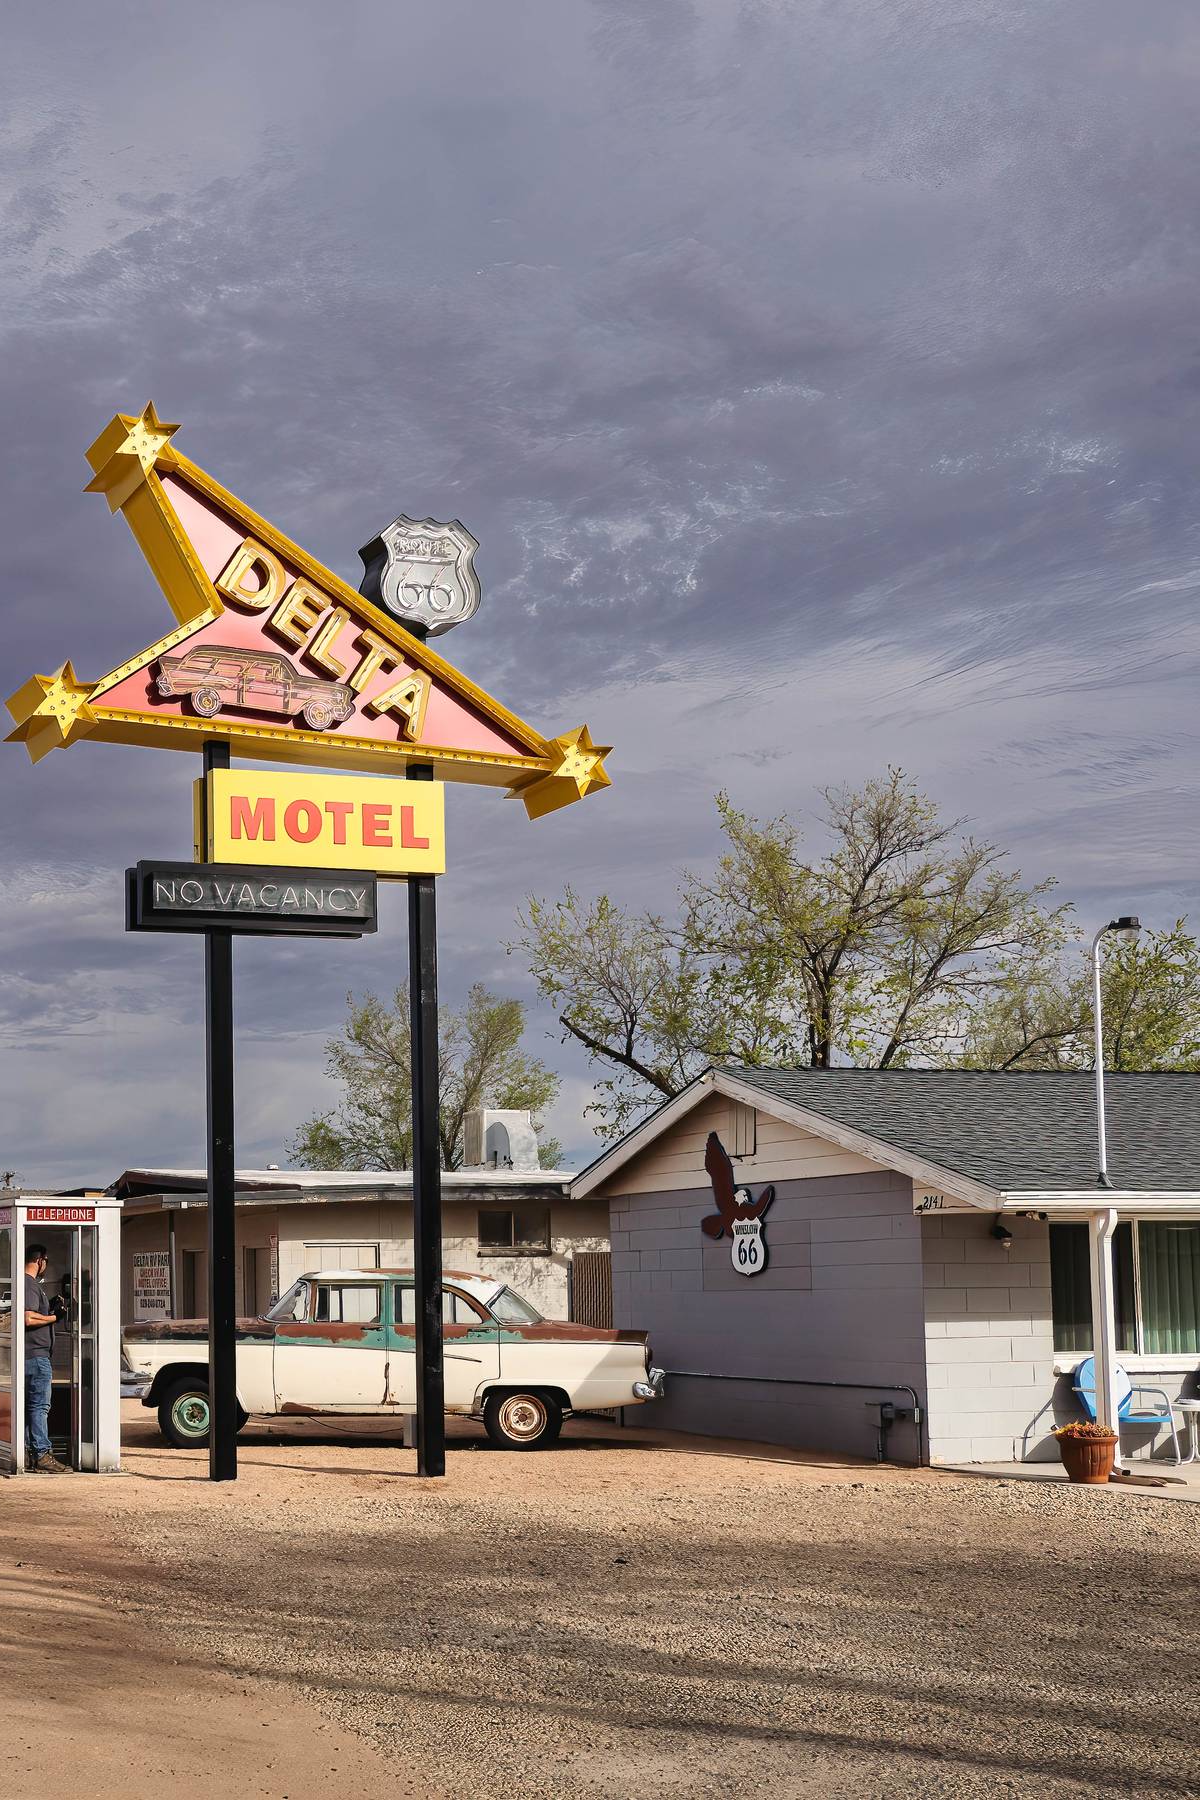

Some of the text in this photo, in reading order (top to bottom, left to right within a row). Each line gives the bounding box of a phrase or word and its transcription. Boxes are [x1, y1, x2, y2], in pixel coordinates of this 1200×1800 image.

[397, 563, 455, 612] 66
[216, 537, 432, 741] DELTA
[230, 796, 429, 849] MOTEL
[156, 880, 366, 911] NO VACANCY
[28, 1209, 93, 1220] TELEPHONE
[923, 1196, 944, 1209] 2141
[738, 1238, 758, 1266] 66
